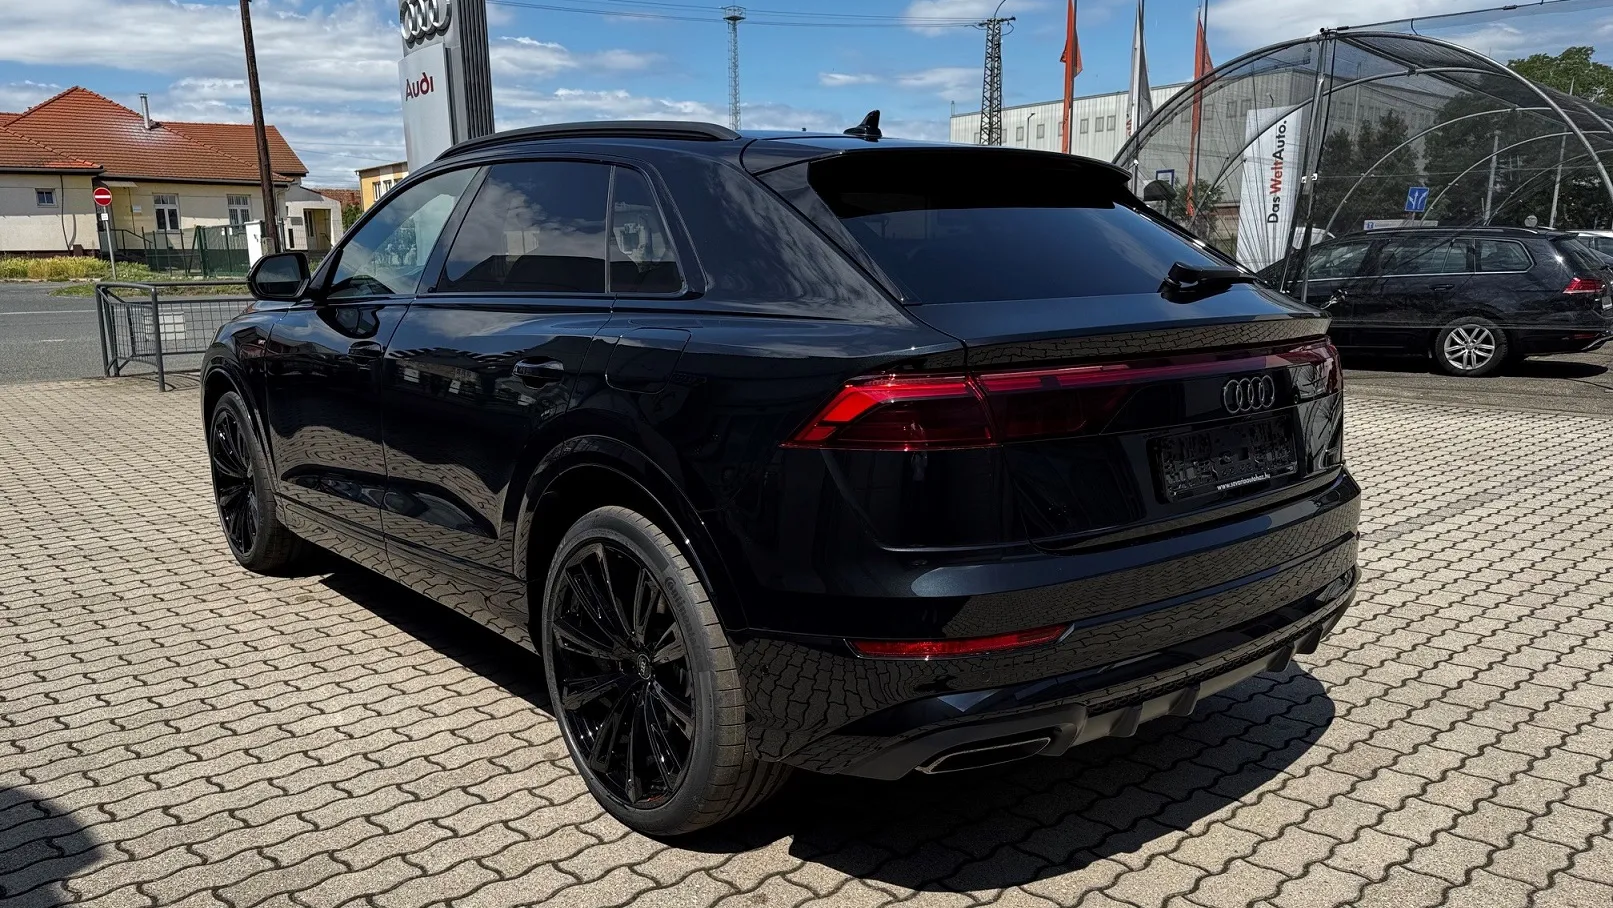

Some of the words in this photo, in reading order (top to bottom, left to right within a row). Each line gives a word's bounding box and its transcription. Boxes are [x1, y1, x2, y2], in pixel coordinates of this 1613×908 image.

[405, 72, 434, 101] Audi
[1269, 120, 1287, 195] WeltAuto.
[1267, 196, 1281, 223] Das
